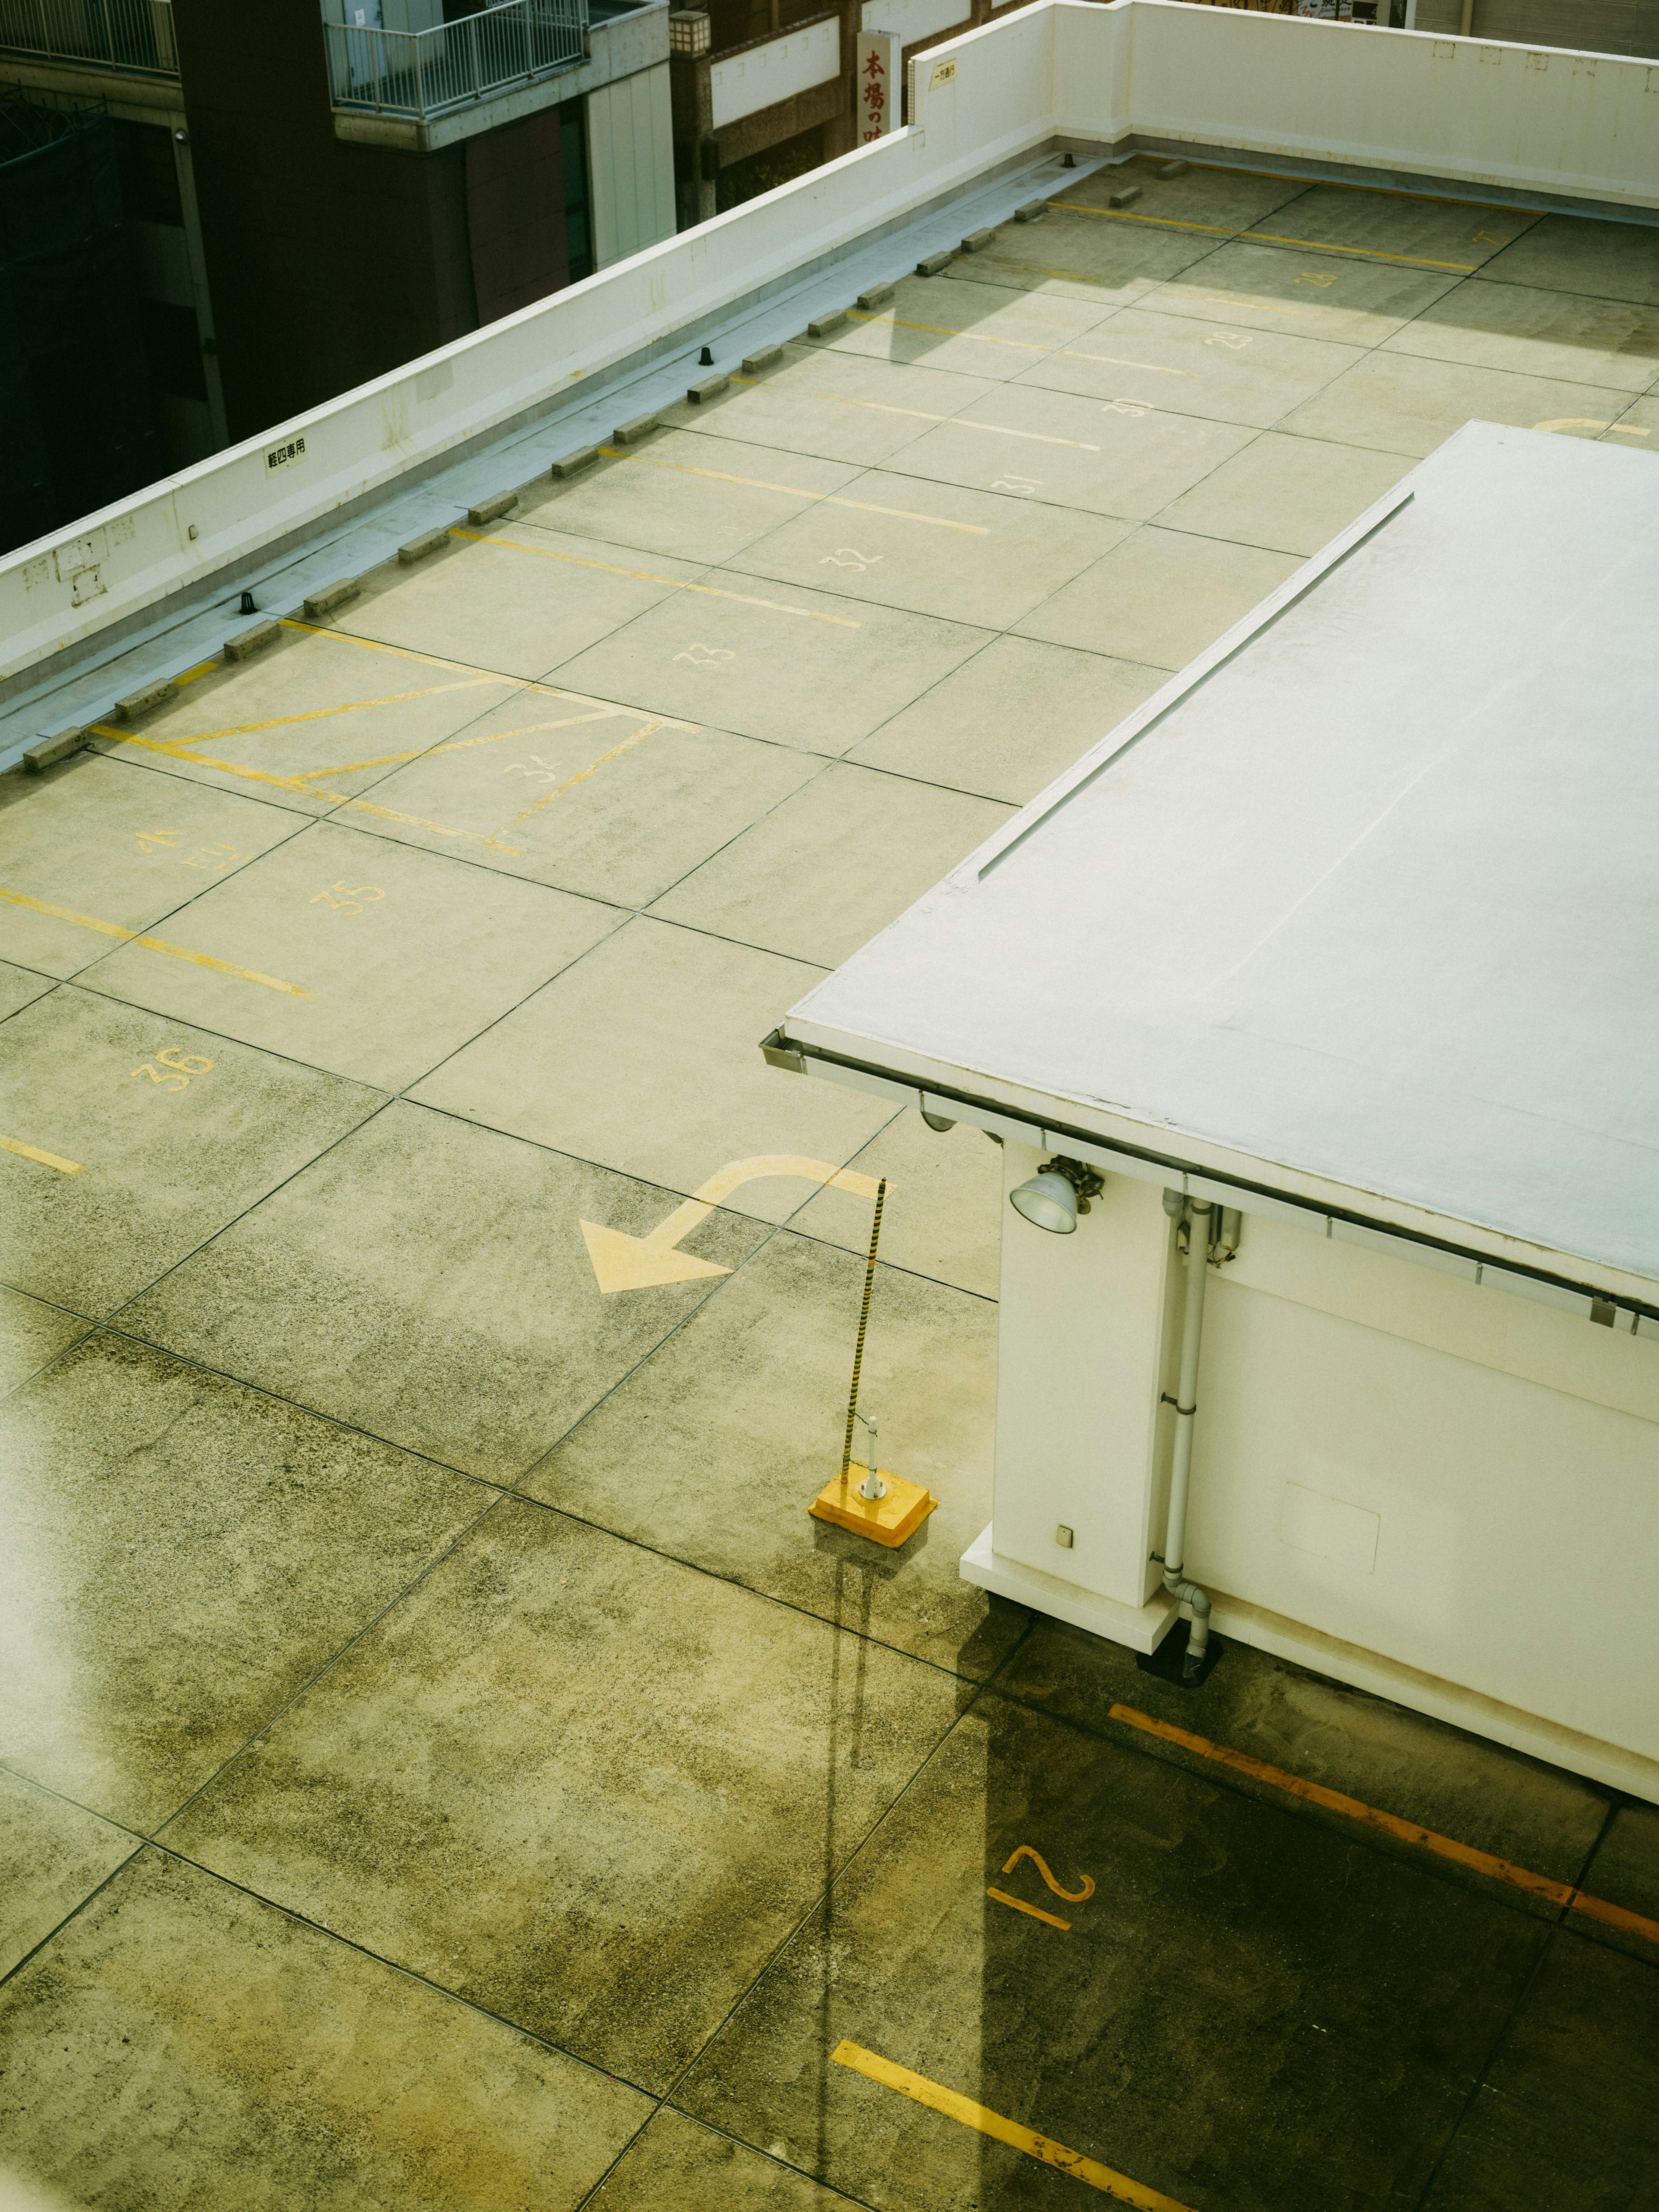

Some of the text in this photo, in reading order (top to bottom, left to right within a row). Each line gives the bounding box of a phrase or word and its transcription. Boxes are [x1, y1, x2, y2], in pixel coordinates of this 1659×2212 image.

[935, 65, 955, 81] 一方通行
[1471, 230, 1511, 246] 27
[1293, 272, 1338, 288] 28
[1205, 332, 1253, 349] 29
[1101, 398, 1154, 417] 30
[268, 438, 305, 468] 軽四専用
[992, 474, 1044, 494] 31
[818, 548, 884, 572] 32
[672, 643, 735, 670] 33
[309, 880, 385, 916] 35
[130, 1048, 214, 1092] 36
